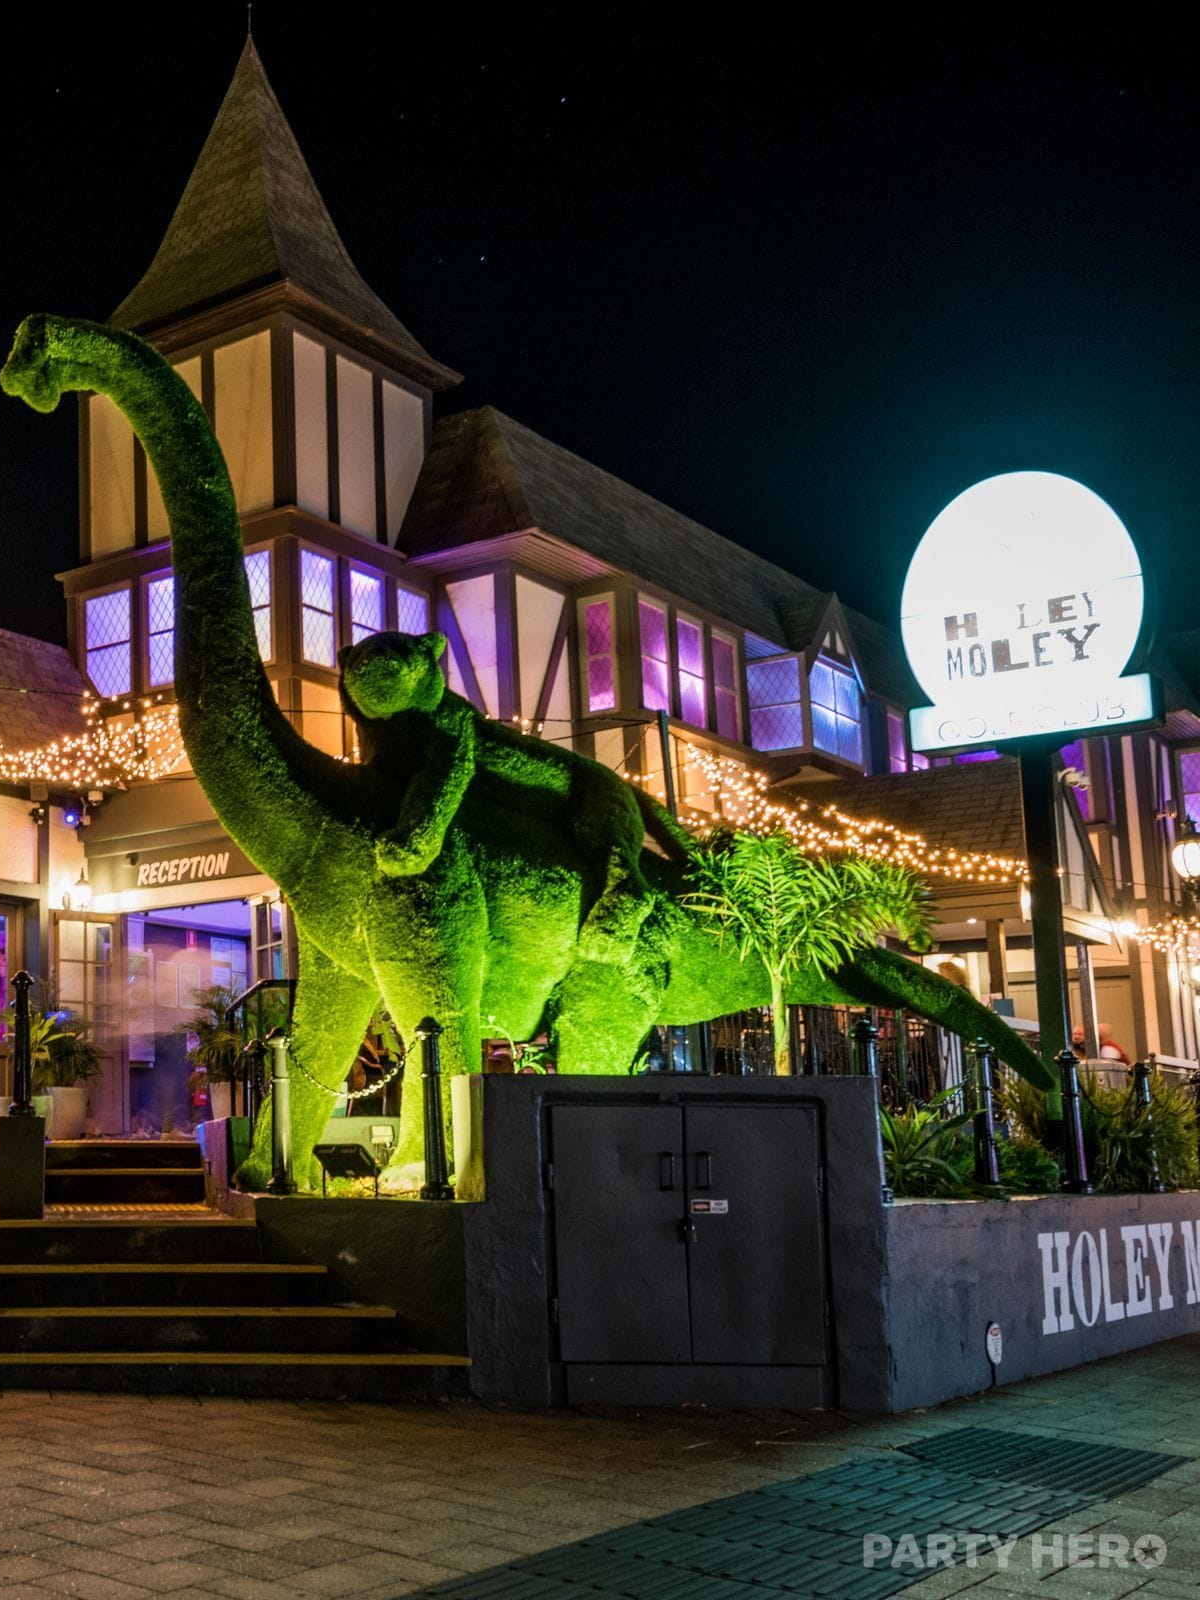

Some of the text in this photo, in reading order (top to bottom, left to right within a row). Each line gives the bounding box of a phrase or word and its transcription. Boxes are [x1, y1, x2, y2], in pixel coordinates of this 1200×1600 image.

[943, 589, 1097, 642] HLEY
[946, 623, 1101, 681] MOLEY
[136, 851, 230, 887] RECEPTION
[1037, 1222, 1174, 1336] HOLEY
